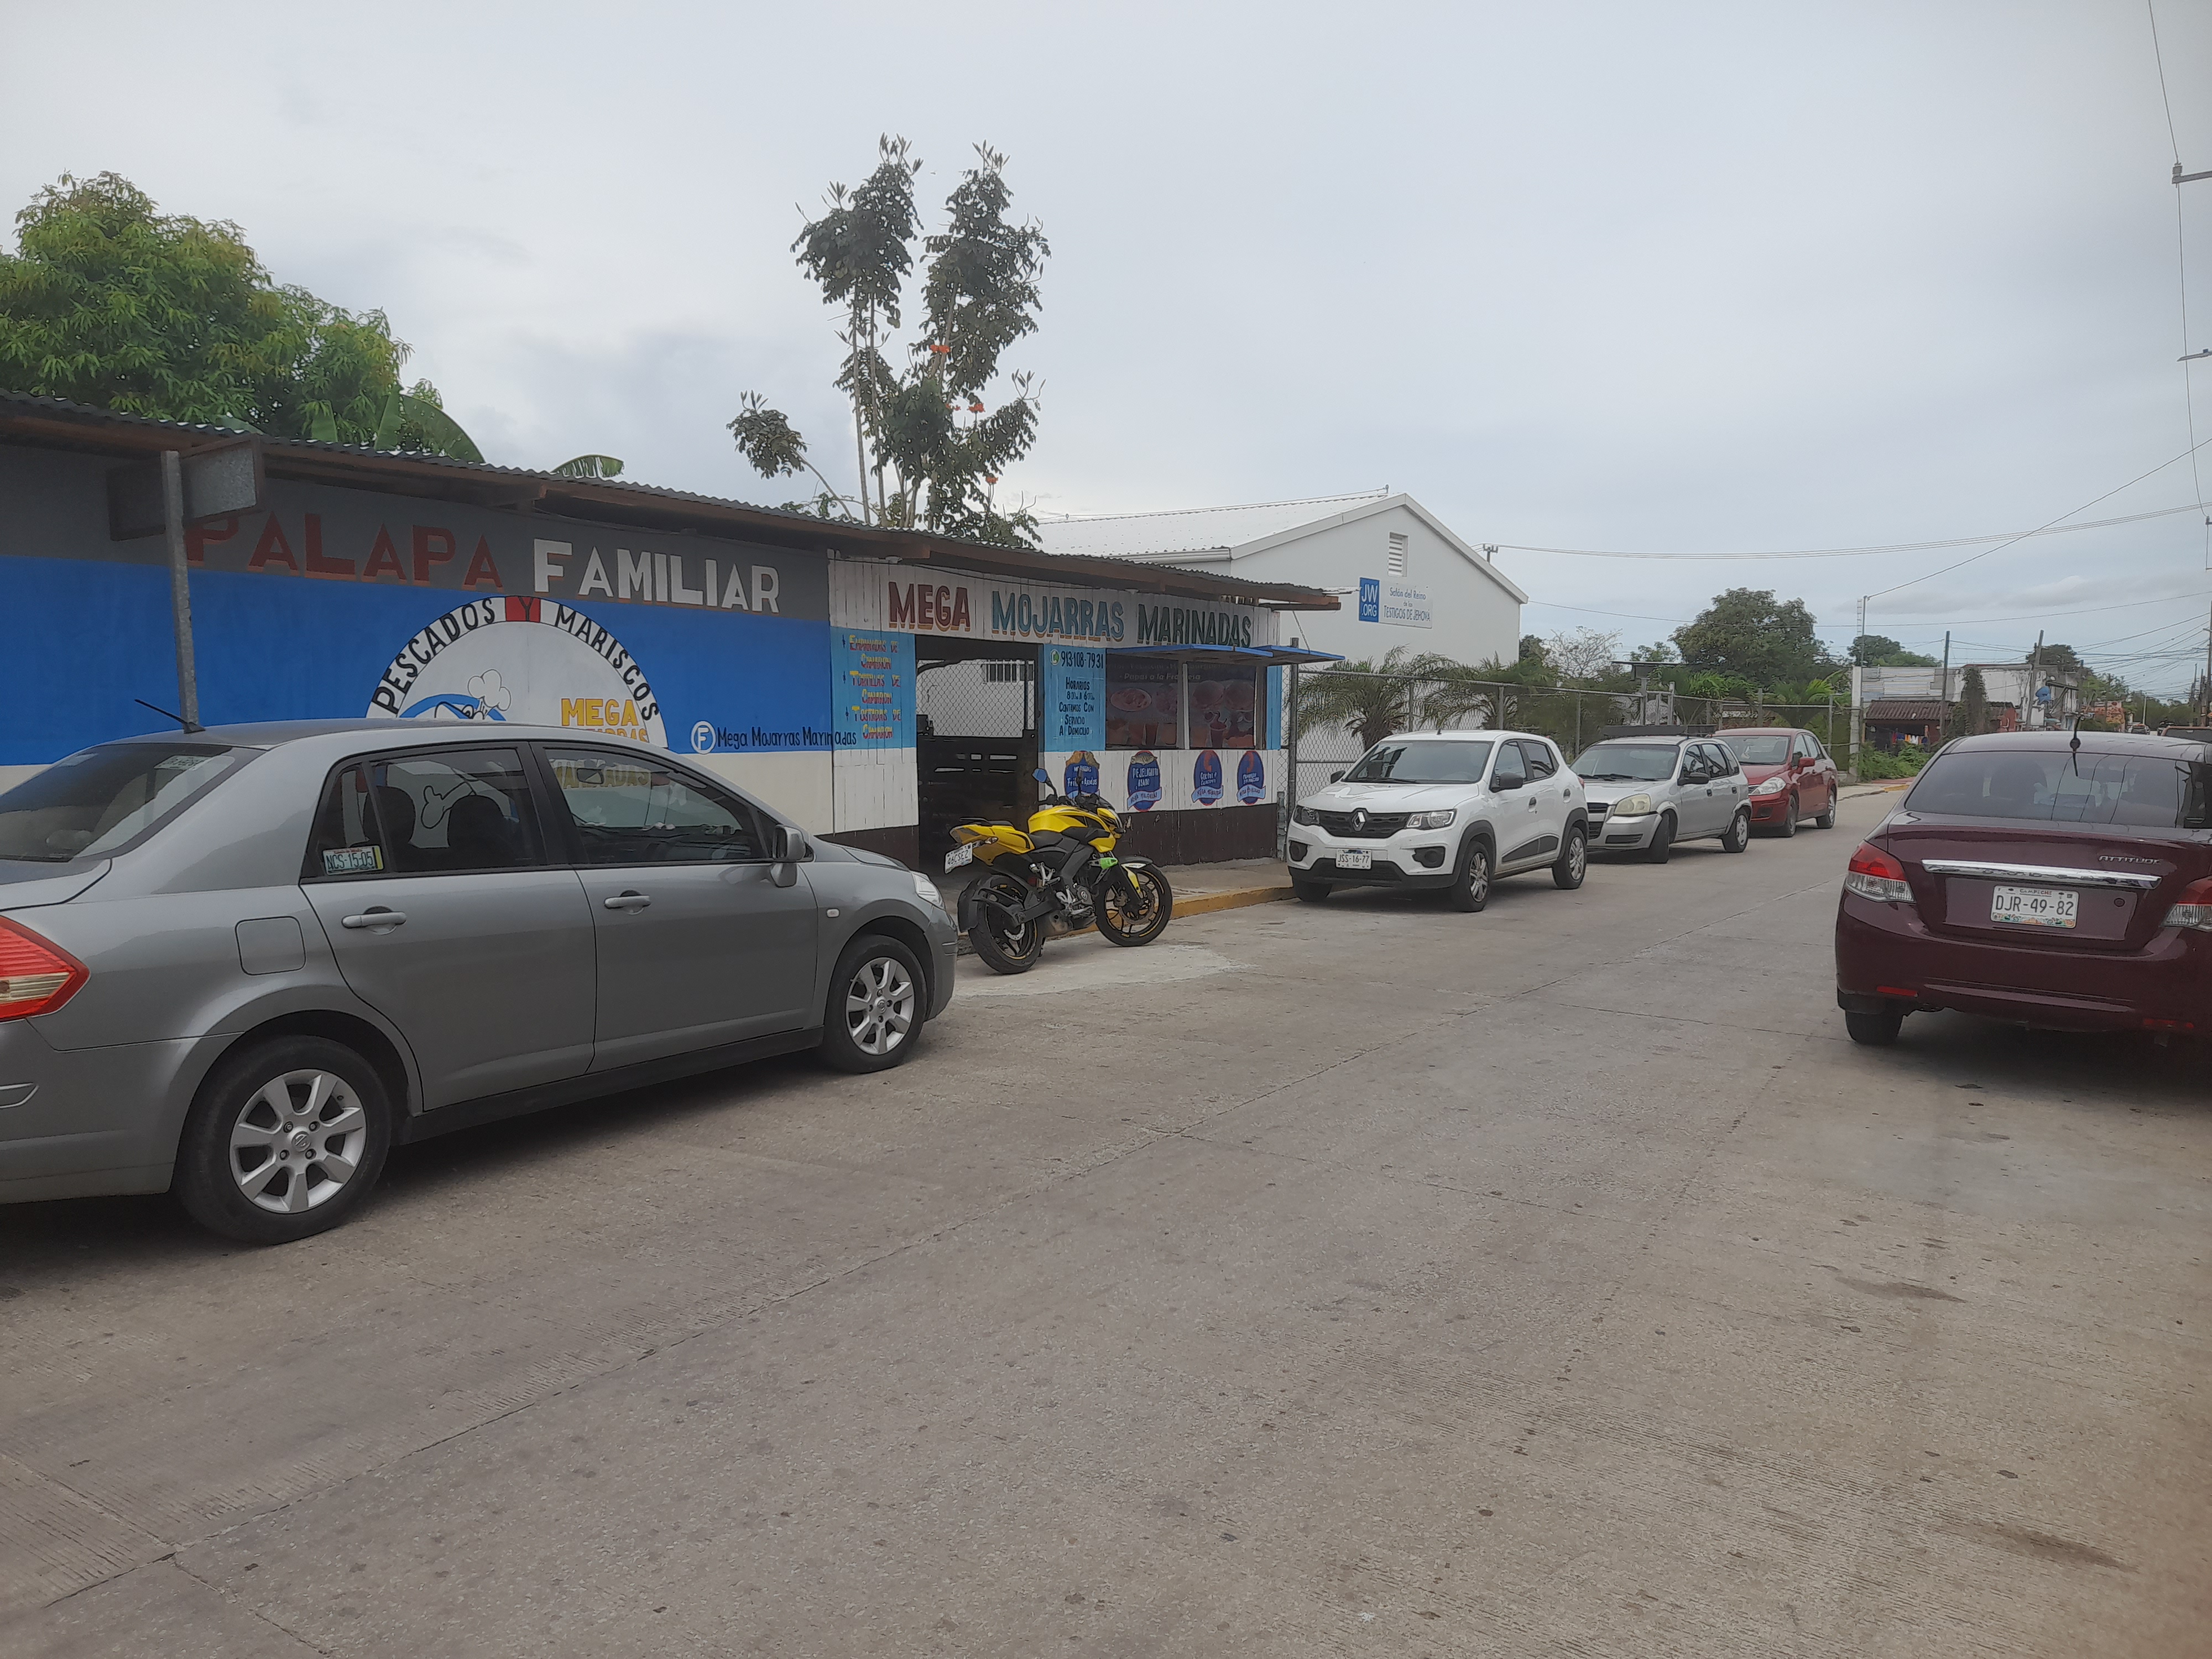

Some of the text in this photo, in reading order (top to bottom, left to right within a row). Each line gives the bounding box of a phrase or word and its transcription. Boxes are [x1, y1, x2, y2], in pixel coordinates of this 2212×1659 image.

[184, 510, 780, 614] PALAPA FAMILIAR
[1361, 584, 1378, 603] JW
[888, 581, 1252, 648] MEGA MOJARRAS MARINADAS
[1384, 606, 1405, 619] TESTIGOS
[1407, 609, 1412, 620] DE
[373, 596, 659, 721] PESCADOS Y MARISCOS
[561, 698, 639, 726] MEGA
[718, 727, 748, 749] Mega
[802, 726, 857, 747] Marinadas
[326, 852, 374, 870] NCS-15-05
[1338, 854, 1370, 863] JSS-16-77
[2099, 855, 2161, 865] ATTITUDE
[1996, 895, 2074, 916] DJR-49-82
